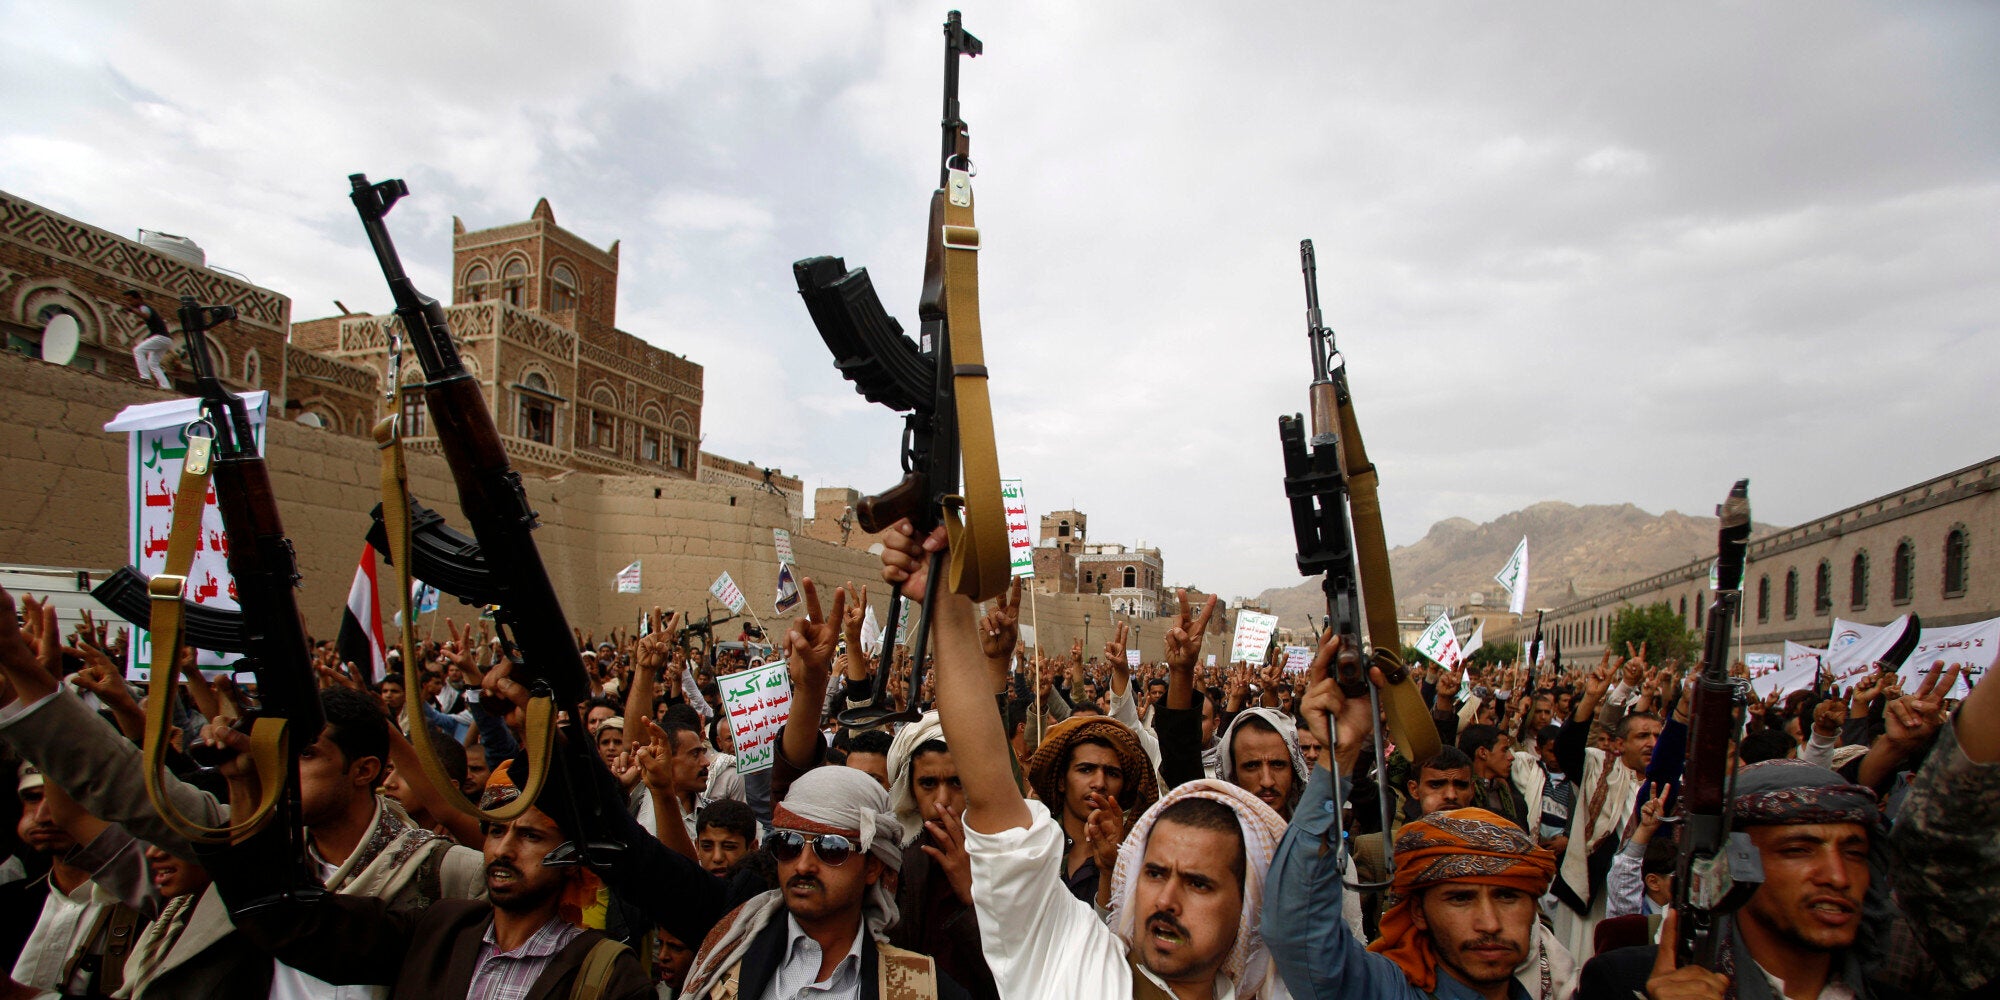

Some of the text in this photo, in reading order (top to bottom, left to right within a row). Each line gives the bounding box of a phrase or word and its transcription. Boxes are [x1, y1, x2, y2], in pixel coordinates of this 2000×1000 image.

[1004, 504, 1026, 516] المو
[727, 670, 788, 702] الله أكبر
[729, 691, 791, 717] الموت لأمريكا
[736, 708, 790, 736] موت لإسرائيل
[738, 735, 762, 752] اليهود
[740, 746, 771, 769] للإسلام
